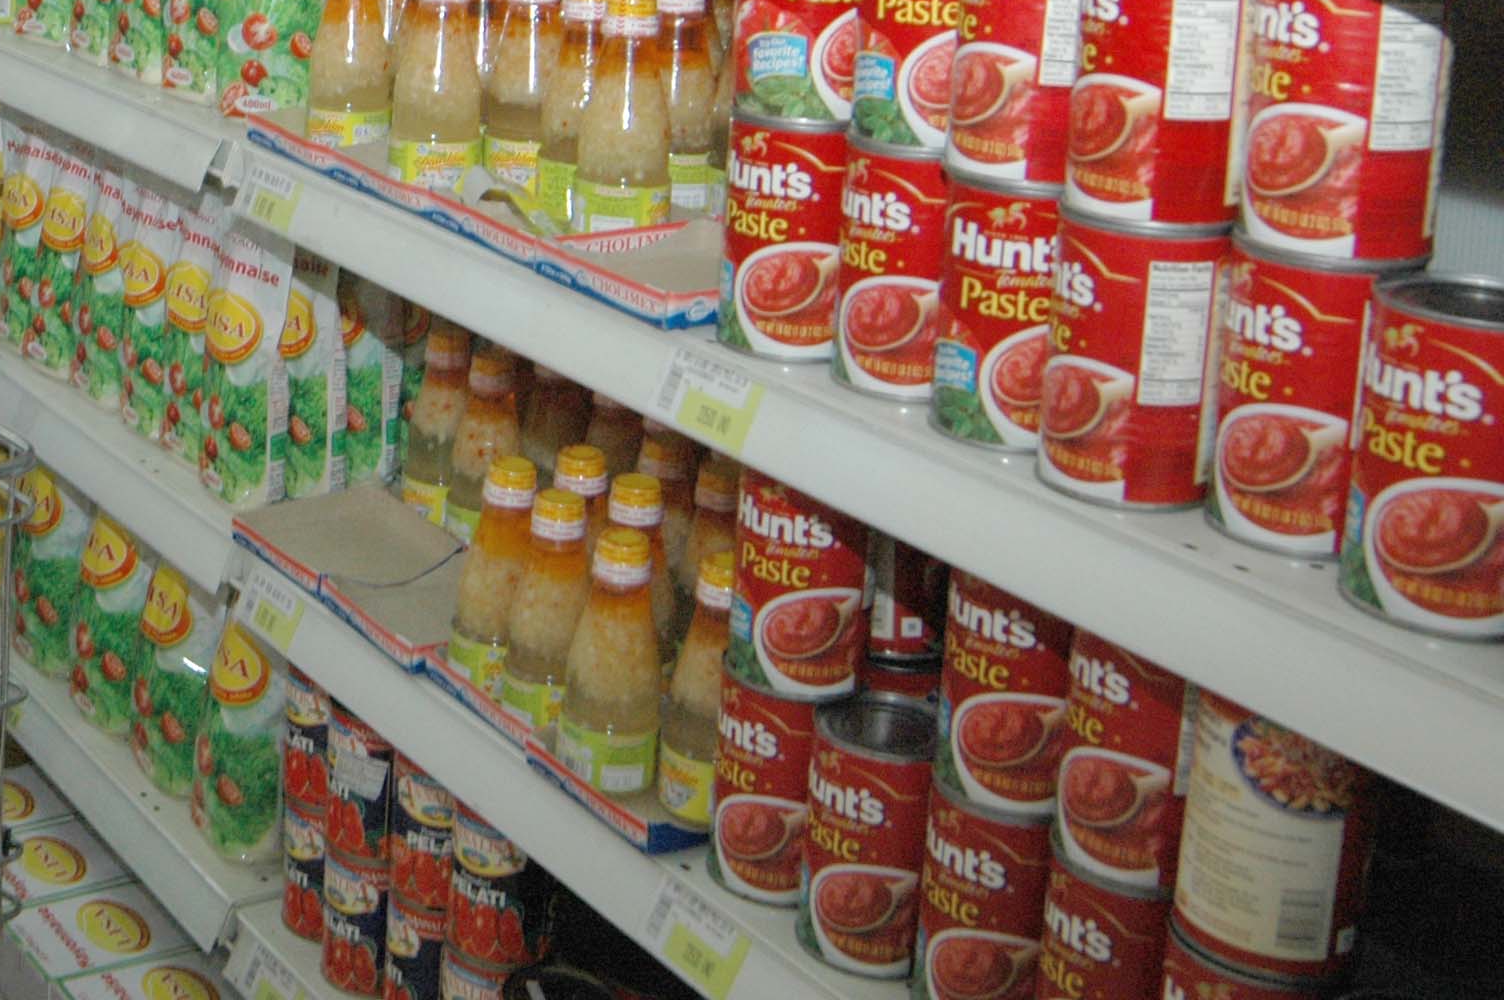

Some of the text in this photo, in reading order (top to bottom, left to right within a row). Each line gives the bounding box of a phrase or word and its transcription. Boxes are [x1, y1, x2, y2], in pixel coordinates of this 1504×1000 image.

[841, 187, 912, 231] unt's
[960, 275, 1050, 321] Paste
[738, 488, 834, 548] Hunt's
[741, 541, 812, 588] Paste
[808, 757, 885, 825] unt's
[926, 816, 1006, 890] unt's
